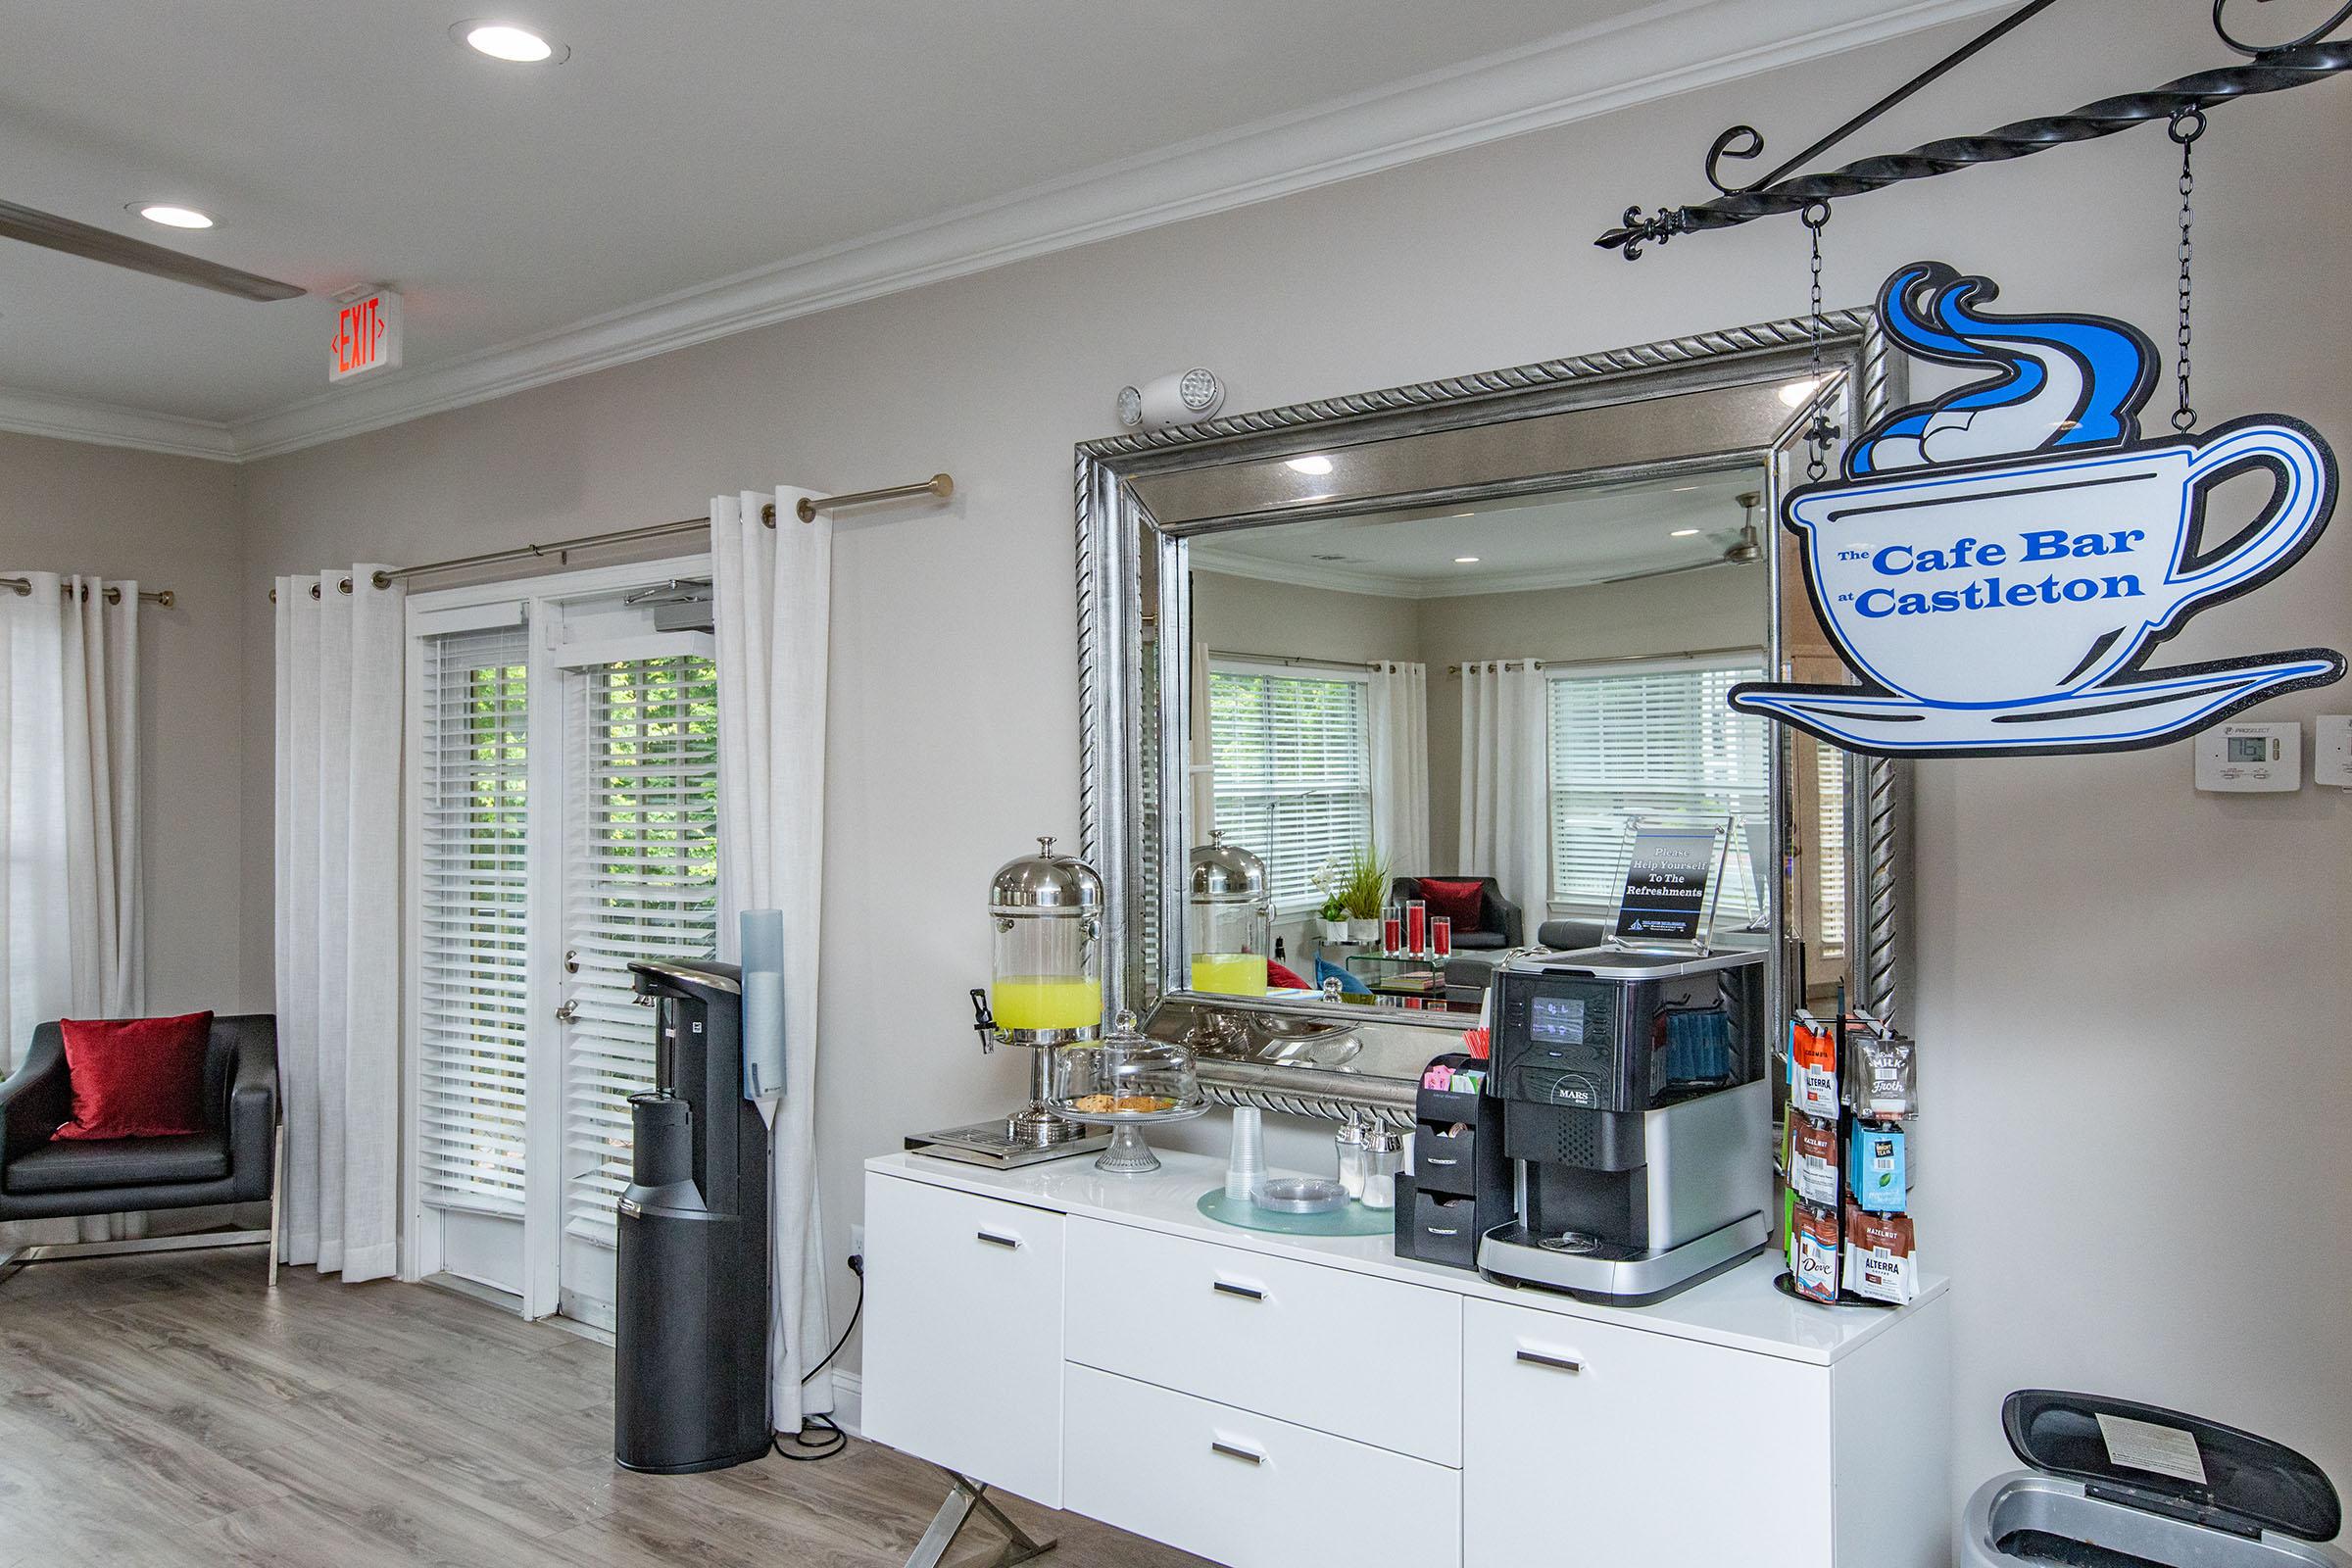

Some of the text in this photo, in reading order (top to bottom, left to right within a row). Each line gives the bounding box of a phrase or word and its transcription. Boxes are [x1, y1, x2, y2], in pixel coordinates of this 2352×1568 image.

[339, 298, 379, 372] EXIT
[1838, 529, 2146, 575] The Cafe Bar
[1838, 574, 2146, 618] at Castleton
[1654, 848, 1690, 858] Please
[1633, 860, 1707, 871] Help Yourself
[1648, 873, 1685, 884] To The
[1626, 885, 1703, 898] Refreshments
[1873, 1057, 1903, 1069] MILK
[1871, 1080, 1905, 1094] Froth
[1559, 1089, 1589, 1100] MARS
[1866, 1227, 1898, 1239] HAZELNUT
[1802, 1257, 1833, 1275] Dove
[1865, 1257, 1899, 1275] ALTERRA
